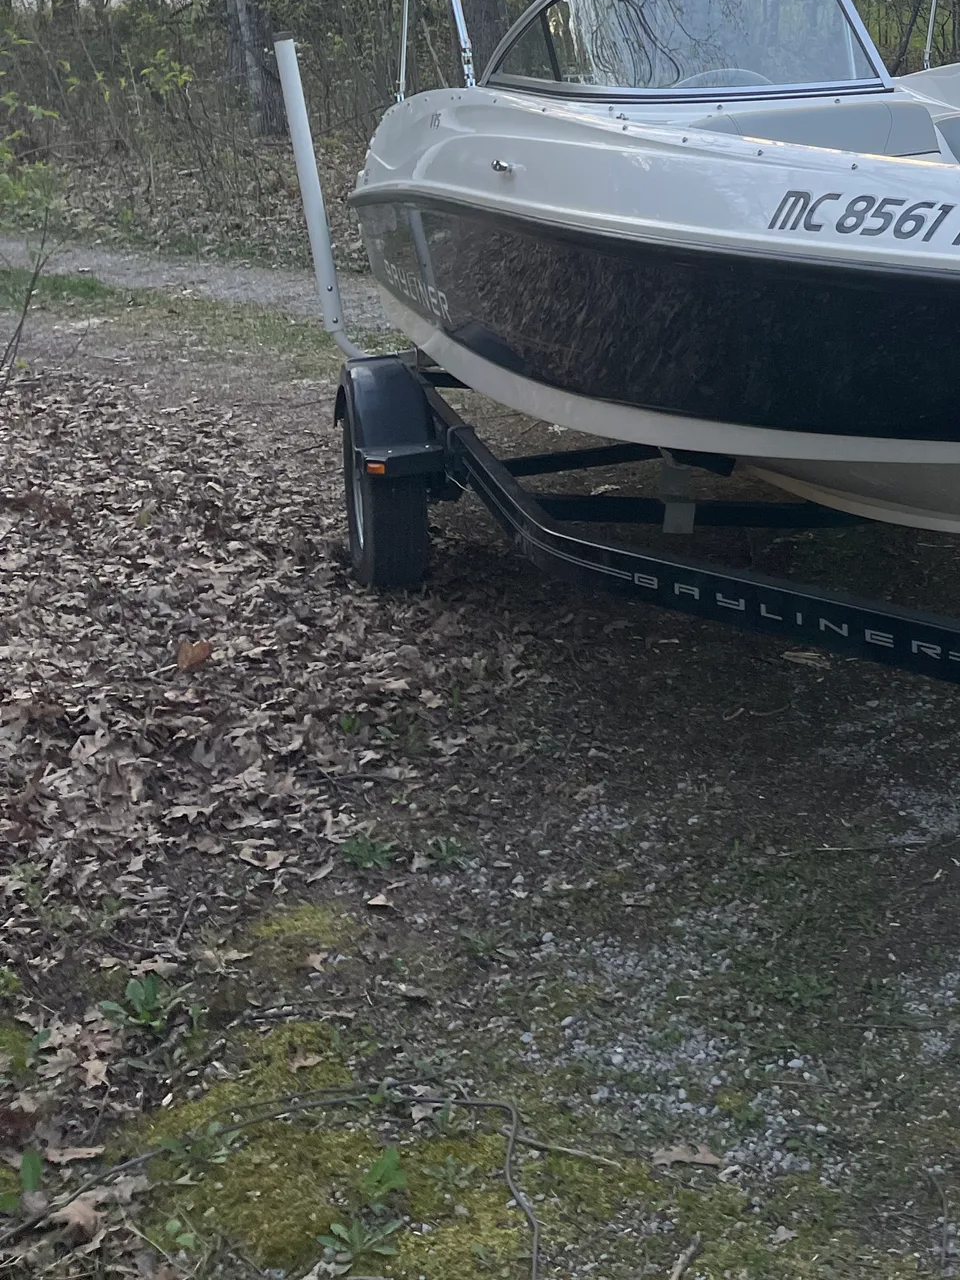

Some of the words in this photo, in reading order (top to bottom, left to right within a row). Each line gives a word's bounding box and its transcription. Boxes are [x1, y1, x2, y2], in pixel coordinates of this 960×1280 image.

[767, 190, 843, 232] MC
[834, 195, 954, 242] 8561
[383, 259, 453, 324] BAYLINER
[633, 572, 942, 660] BAYLINER
